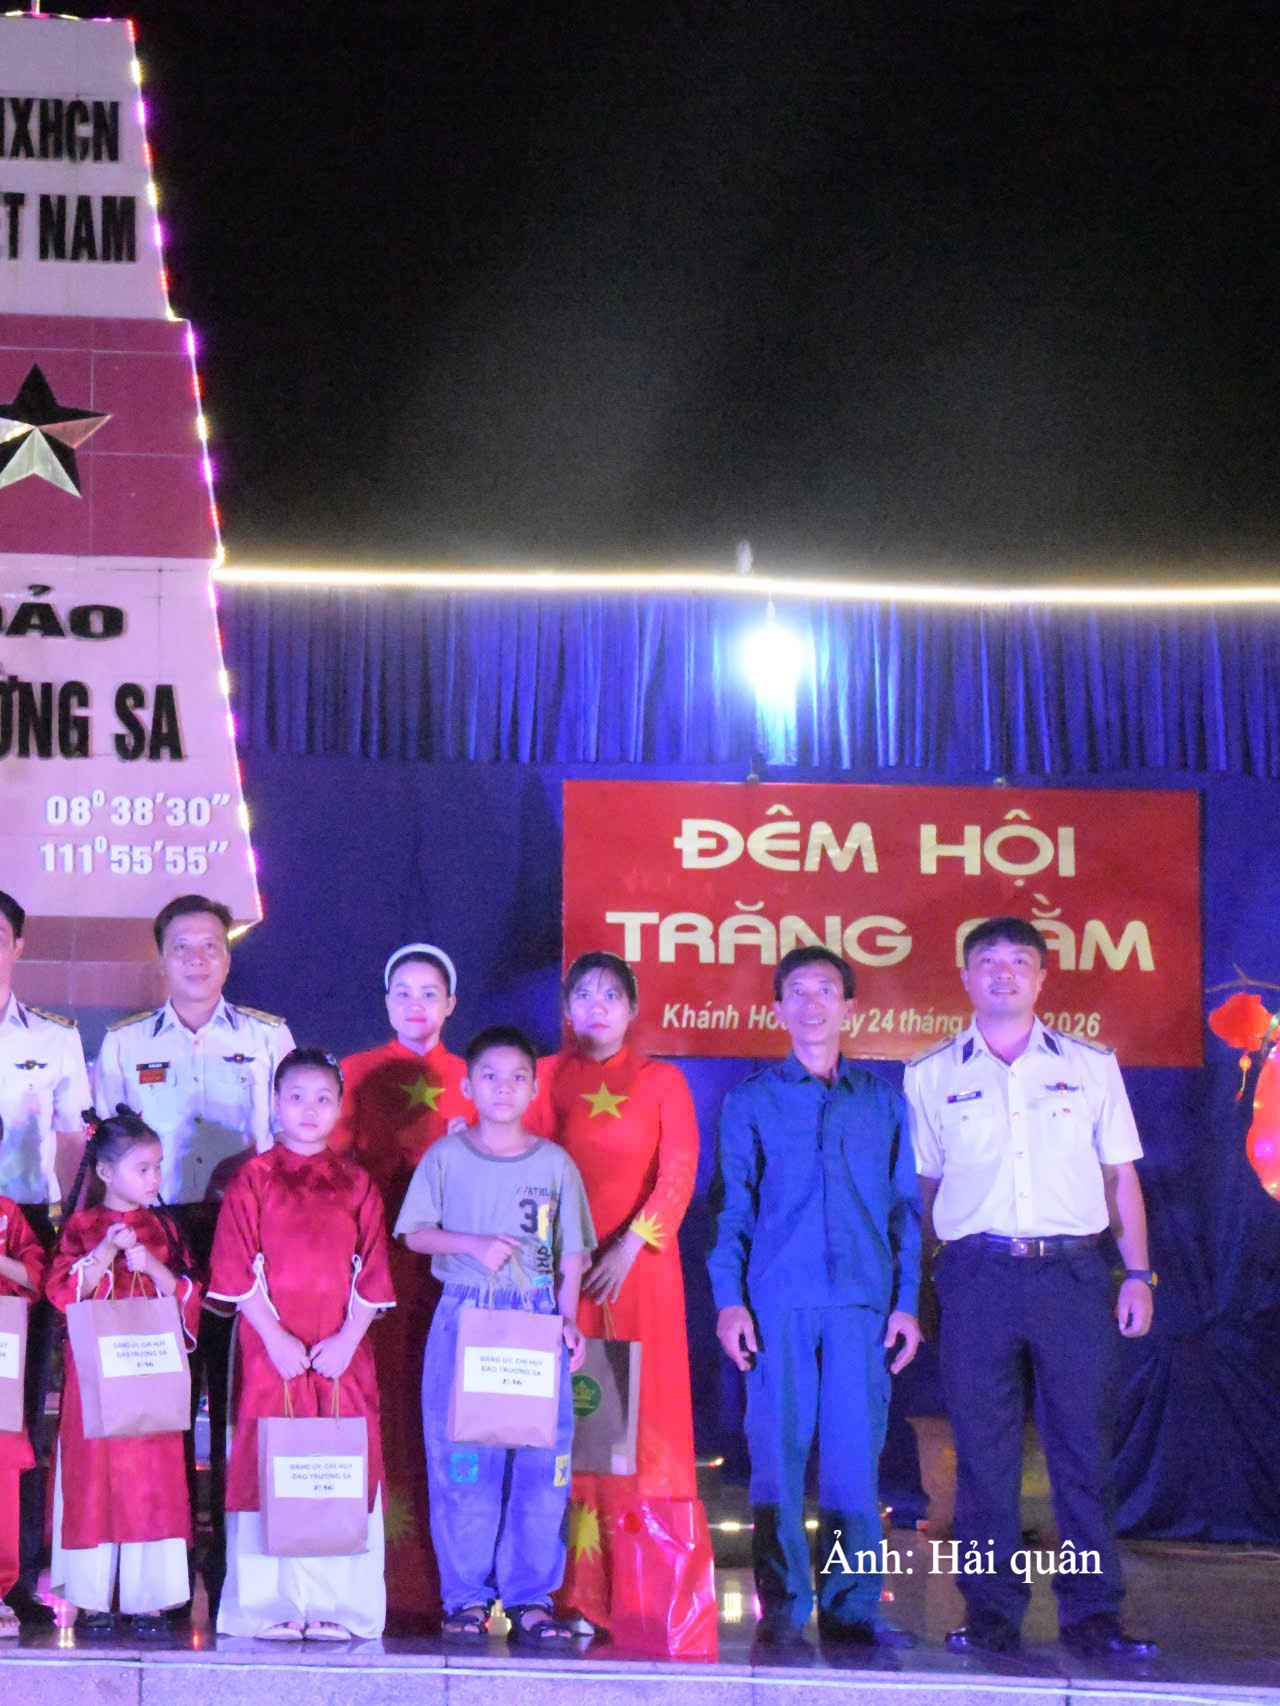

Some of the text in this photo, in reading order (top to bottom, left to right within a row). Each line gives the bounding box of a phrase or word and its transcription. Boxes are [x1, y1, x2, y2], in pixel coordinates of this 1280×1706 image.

[38, 194, 137, 263] NAM
[113, 683, 184, 761] SA
[674, 804, 1076, 887] ĐÊM HỘI
[606, 900, 912, 967] TRĂNG
[663, 1001, 739, 1029] Khánh
[868, 1007, 895, 1033] 24
[900, 1007, 963, 1036] tháng
[1043, 1011, 1101, 1037] 2026
